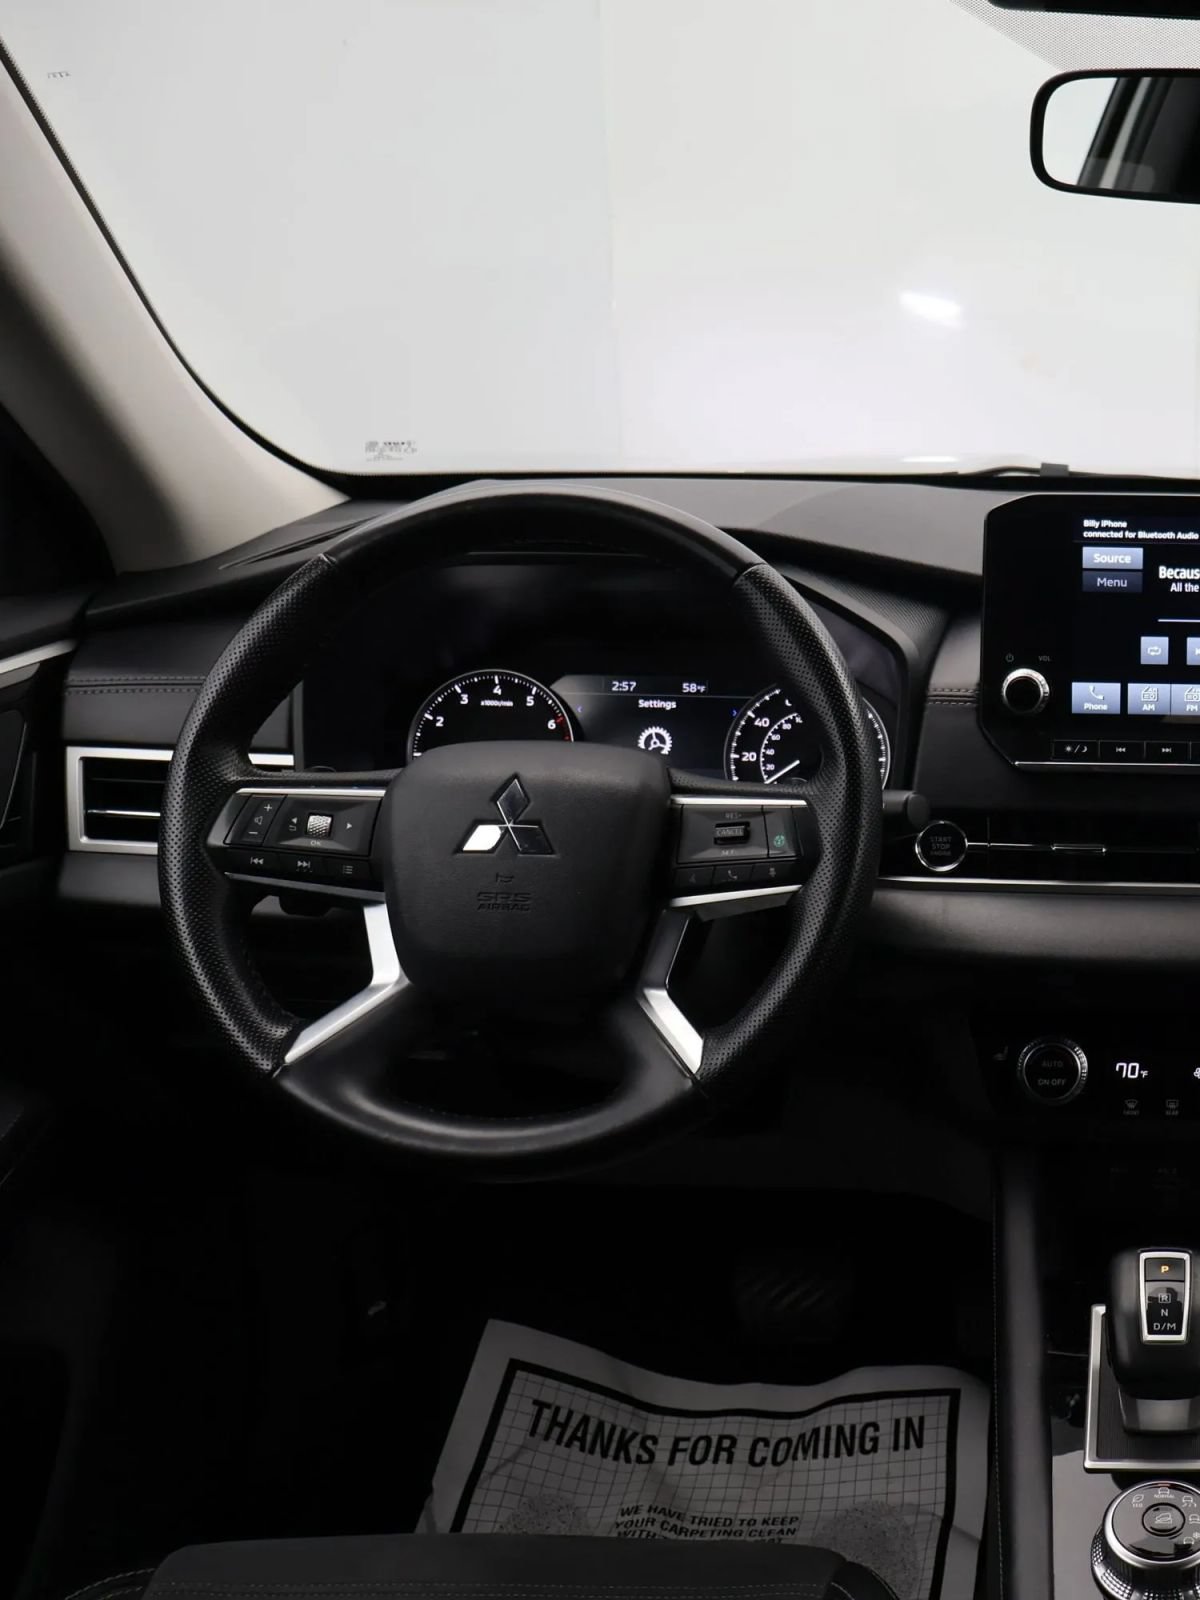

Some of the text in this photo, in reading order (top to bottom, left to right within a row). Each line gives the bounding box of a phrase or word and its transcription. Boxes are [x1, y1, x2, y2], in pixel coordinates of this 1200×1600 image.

[1083, 519, 1127, 529] Billy iPhone
[1083, 530, 1199, 540] connected for Bluetooth Audio
[1093, 553, 1132, 564] Source
[1096, 577, 1128, 588] Menu
[1170, 582, 1182, 593] All
[1184, 583, 1199, 593] the
[493, 685, 502, 695] 4
[611, 681, 637, 692] 2:57
[460, 694, 469, 704] 3
[526, 696, 535, 706] 5
[638, 699, 677, 710] Settings
[1083, 703, 1108, 711] Phone
[1186, 704, 1198, 712] FM
[435, 716, 444, 727] 2
[547, 719, 556, 729] 6
[754, 717, 770, 728] 40
[741, 751, 757, 762] 20
[766, 763, 775, 771] 20
[716, 828, 744, 836] CANCEL
[1041, 1060, 1064, 1068] AUTO
[1161, 1265, 1169, 1273] P
[1161, 1308, 1168, 1317] N
[1153, 1322, 1176, 1331] D/M
[529, 1399, 924, 1467] THANKS FOR COMING IN
[620, 1504, 799, 1528] WE HAVE TRIED TO KEEP
[615, 1518, 797, 1538] YOUR CARPETING CLEAN
[618, 1529, 657, 1539] WITH
